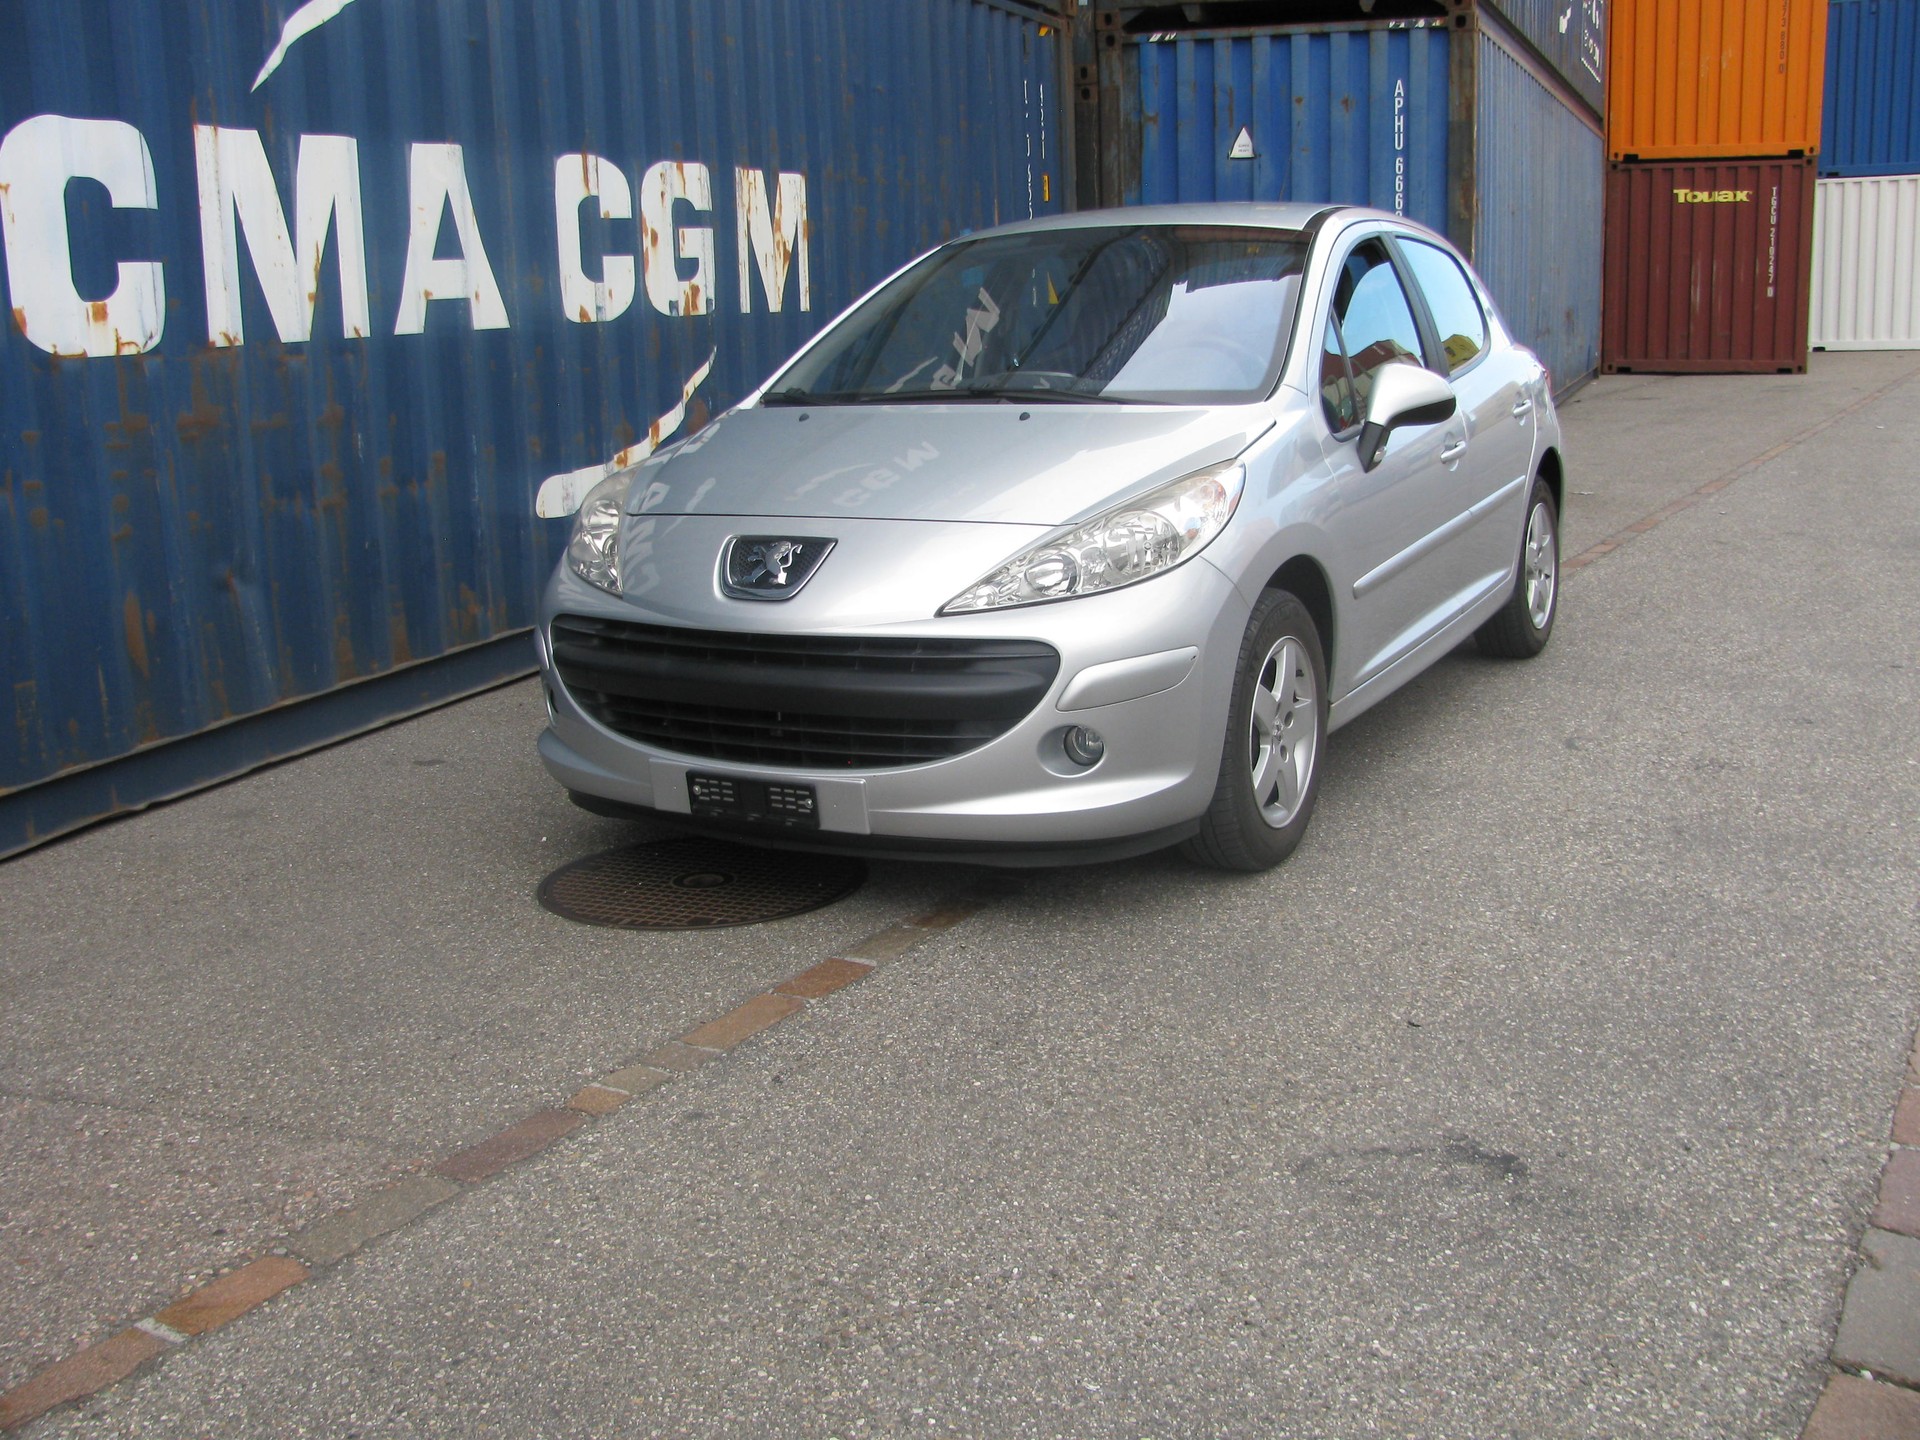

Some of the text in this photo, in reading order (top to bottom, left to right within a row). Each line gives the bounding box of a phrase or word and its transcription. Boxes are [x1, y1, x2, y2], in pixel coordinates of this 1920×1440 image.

[1394, 79, 1404, 150] APHU
[0, 114, 811, 358] CMA CGM
